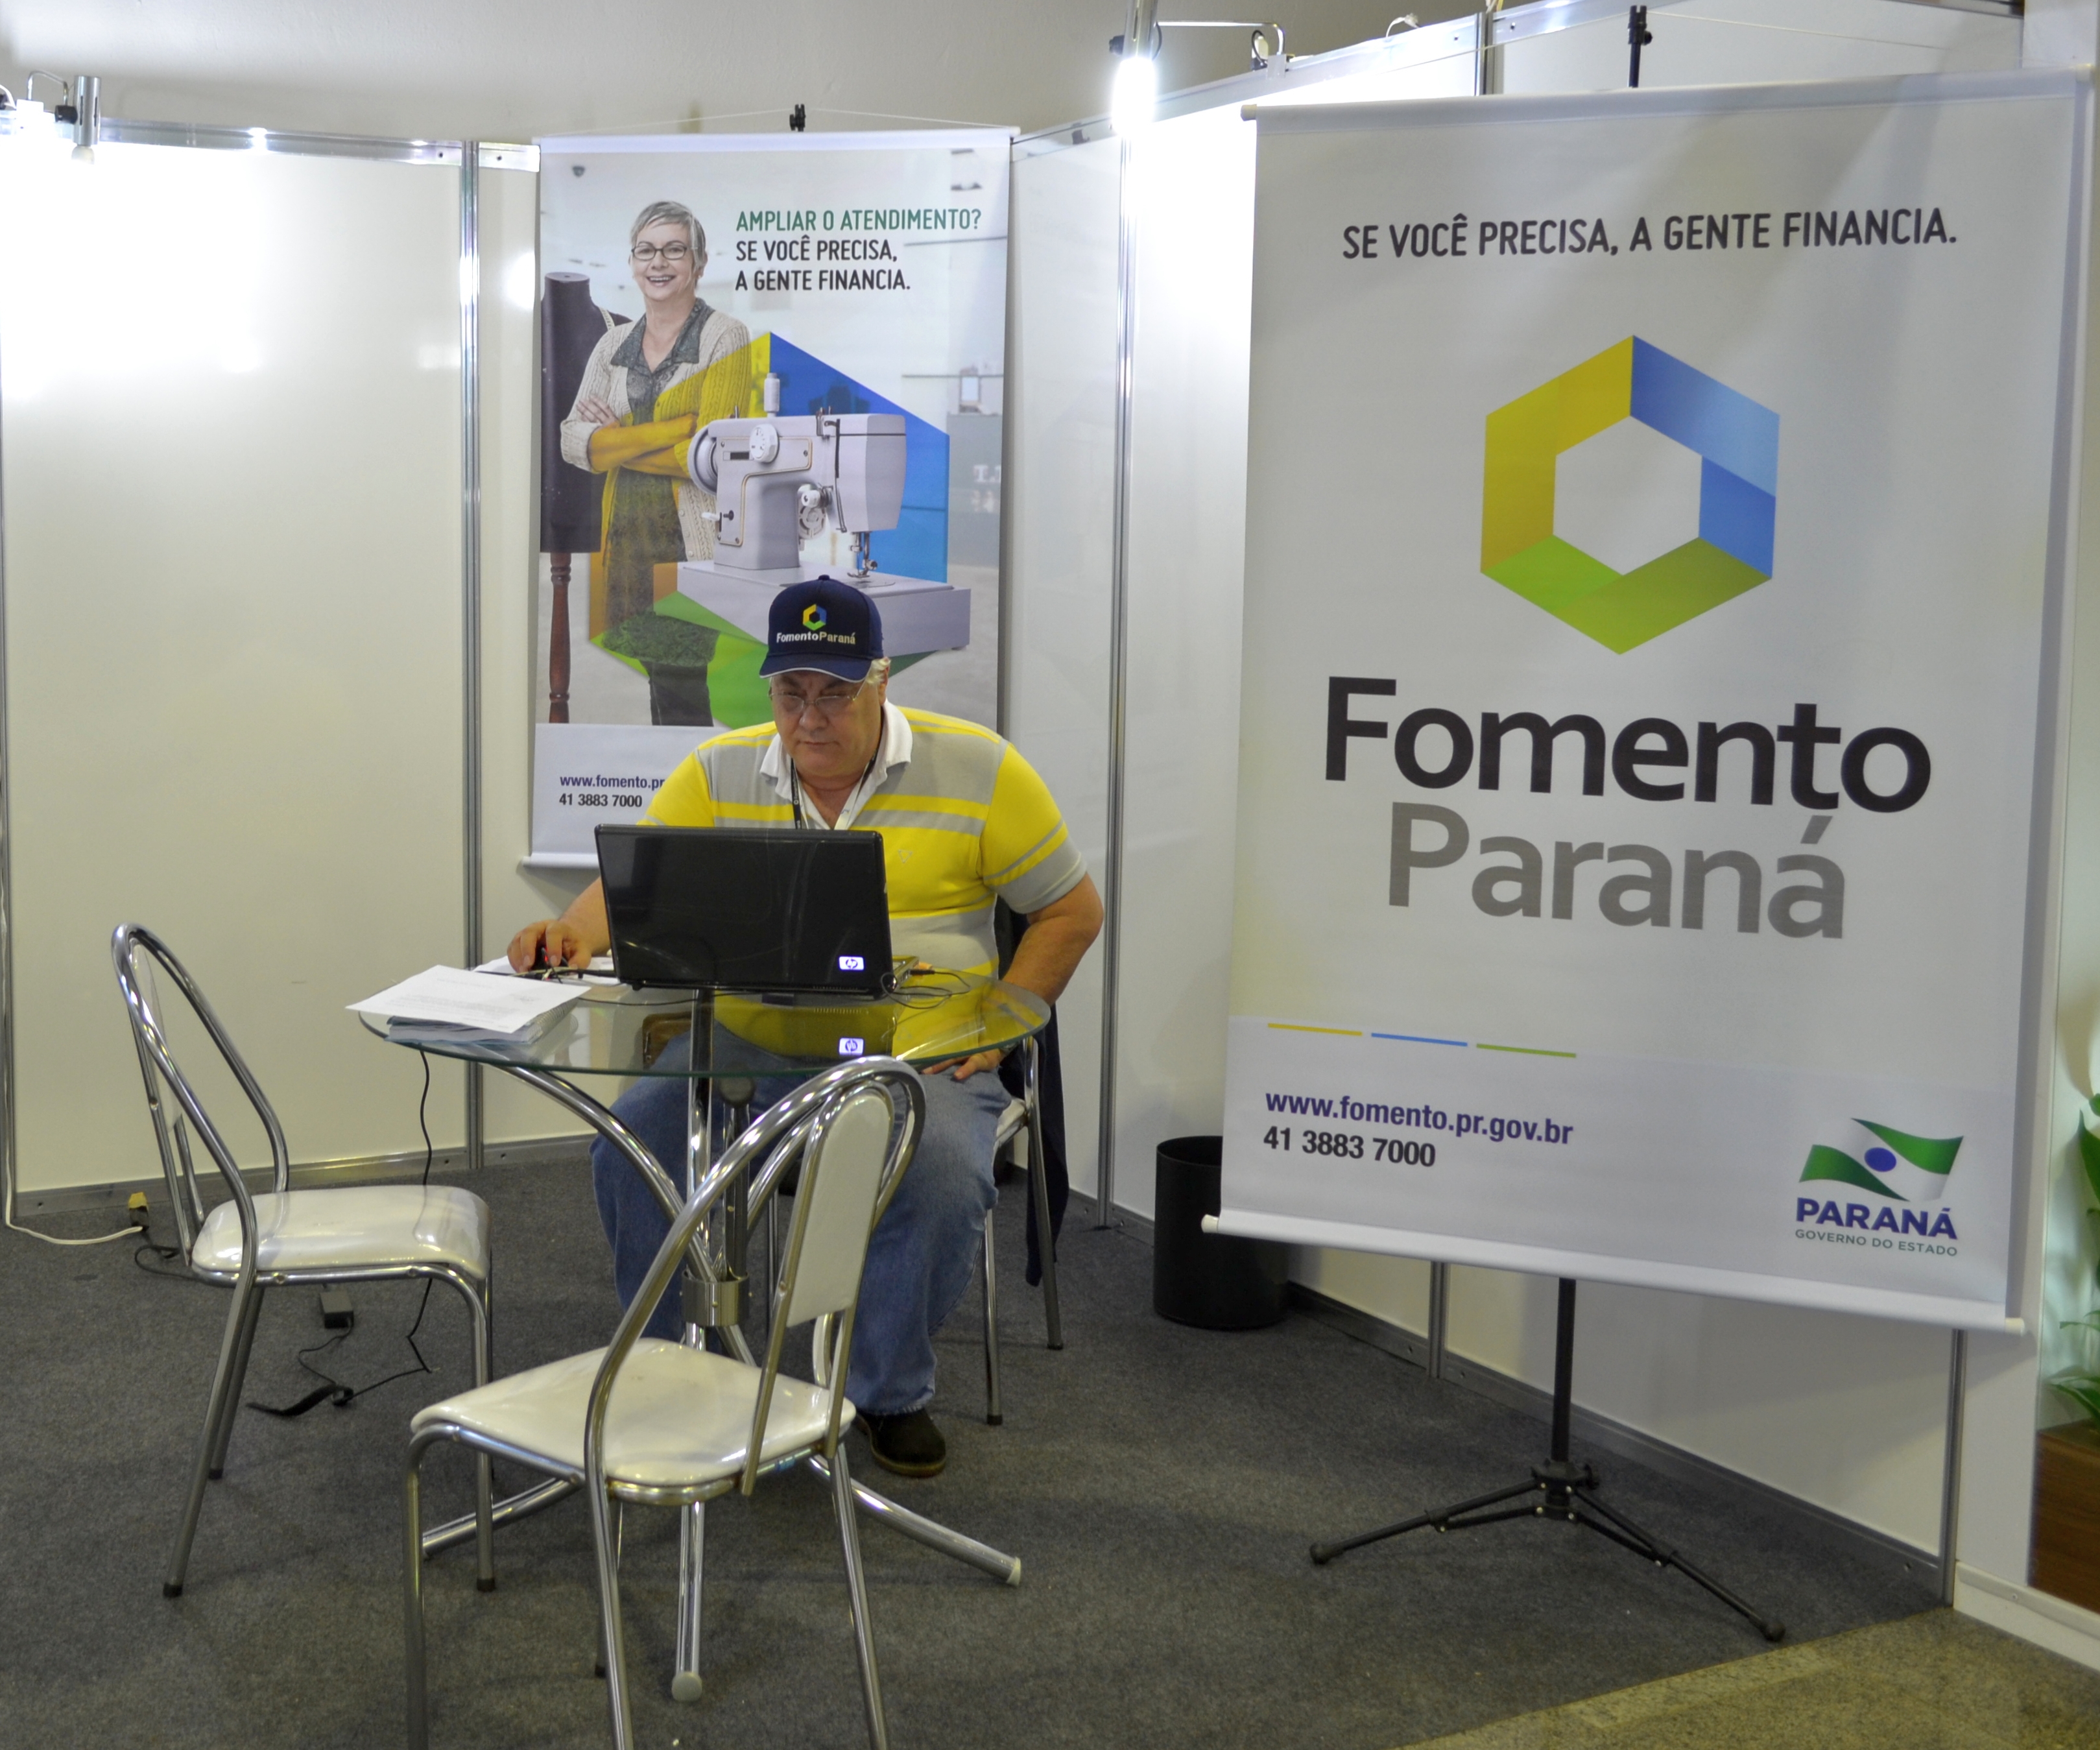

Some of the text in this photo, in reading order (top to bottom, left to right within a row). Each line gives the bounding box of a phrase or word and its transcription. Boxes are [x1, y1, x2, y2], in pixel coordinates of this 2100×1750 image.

[736, 209, 981, 232] AMPLIAR O ATENDIMENTO?
[1342, 208, 1957, 259] SE VOCÊ PRECISA, A GENTE FINANCIA.
[736, 234, 898, 262] SE VOCÊ PRECISA,
[735, 269, 911, 291] A GENTE FINANCIA.
[1325, 676, 1931, 813] Fomento
[559, 793, 643, 808] 41 3883 7000
[1389, 801, 1845, 940] Paraná
[1265, 1092, 1574, 1145] www.fomento.pr.gov.br
[1263, 1125, 1436, 1168] 41 3883 7000
[1795, 1197, 1958, 1241] PARANÁ
[1795, 1229, 1959, 1257] GOVERNO DO ESTADO
